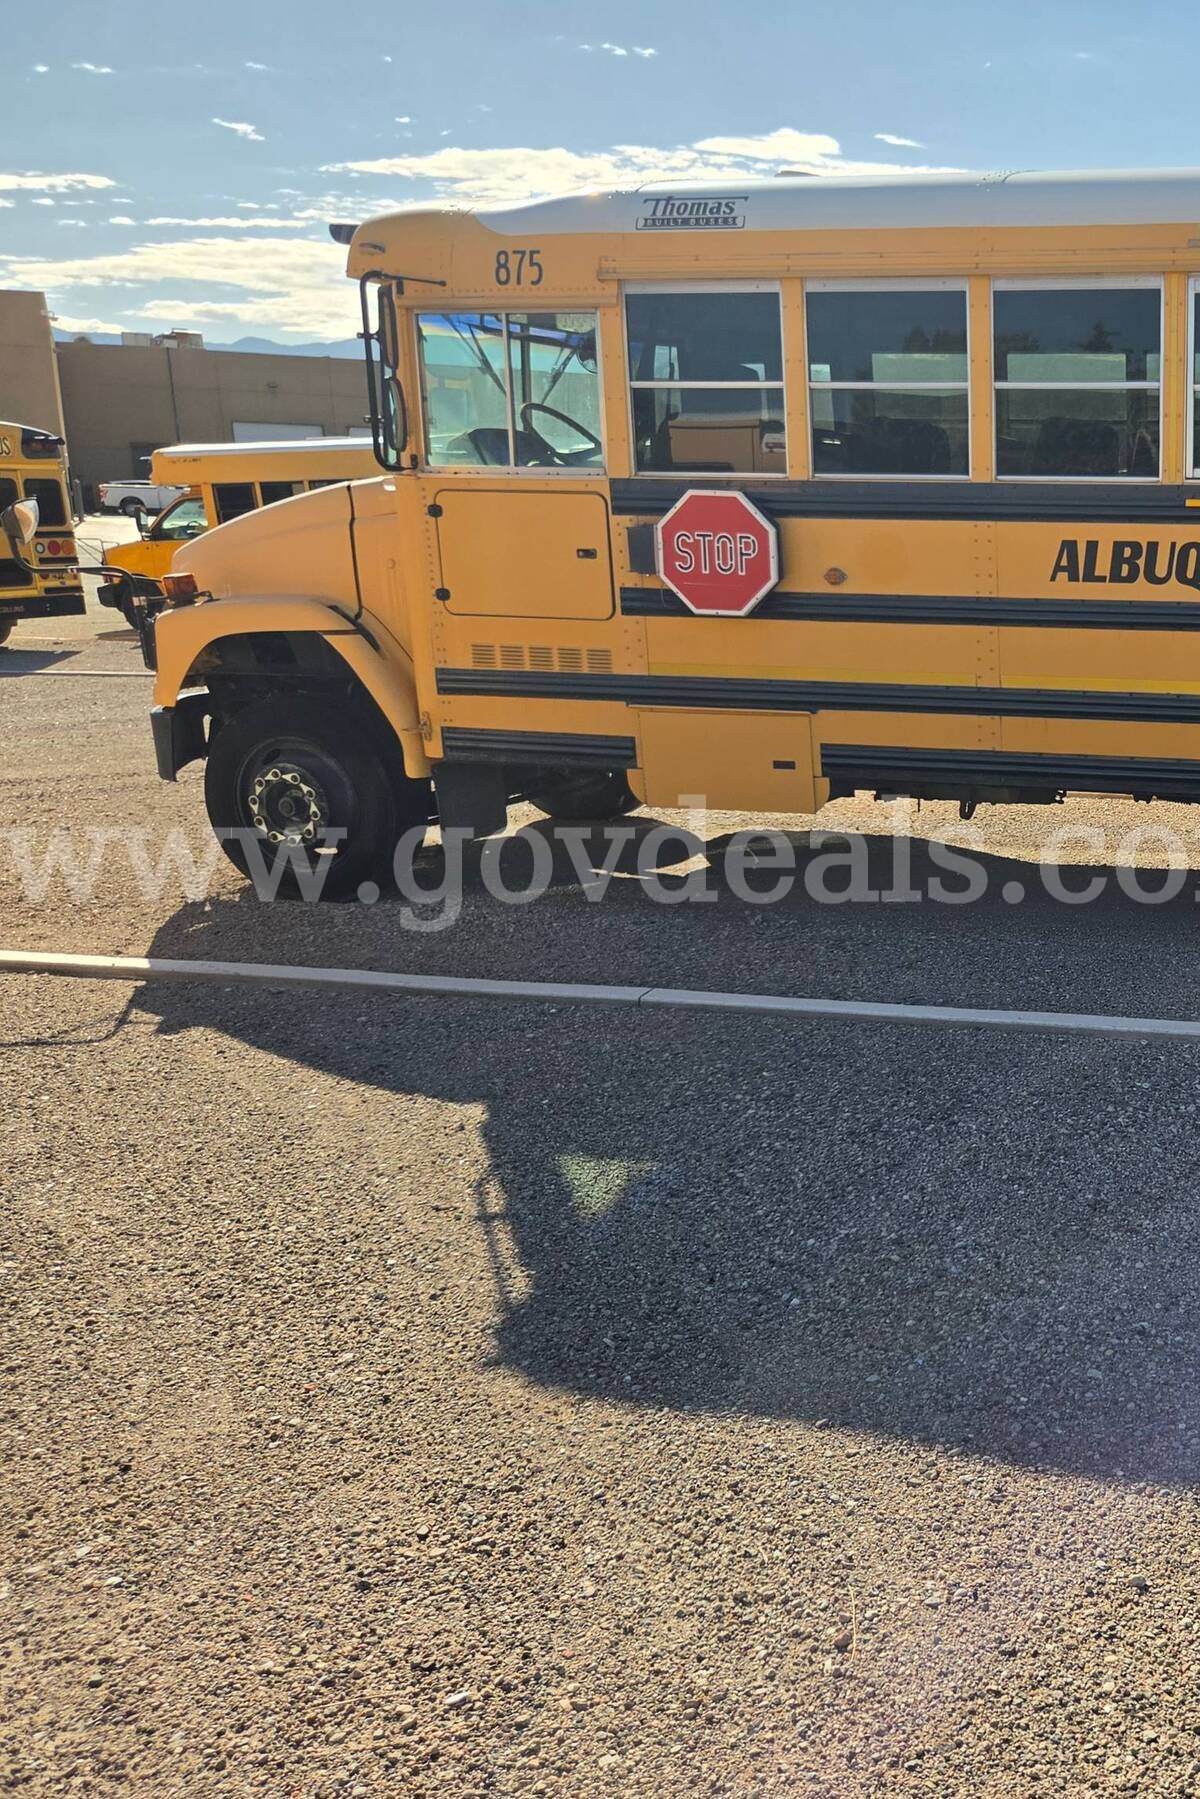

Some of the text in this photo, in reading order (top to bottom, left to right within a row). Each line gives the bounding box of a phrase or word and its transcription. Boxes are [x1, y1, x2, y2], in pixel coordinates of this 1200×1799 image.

[643, 196, 748, 216] Thomas
[647, 217, 683, 226] BUILT
[495, 250, 543, 286] 875
[674, 531, 758, 575] STOP
